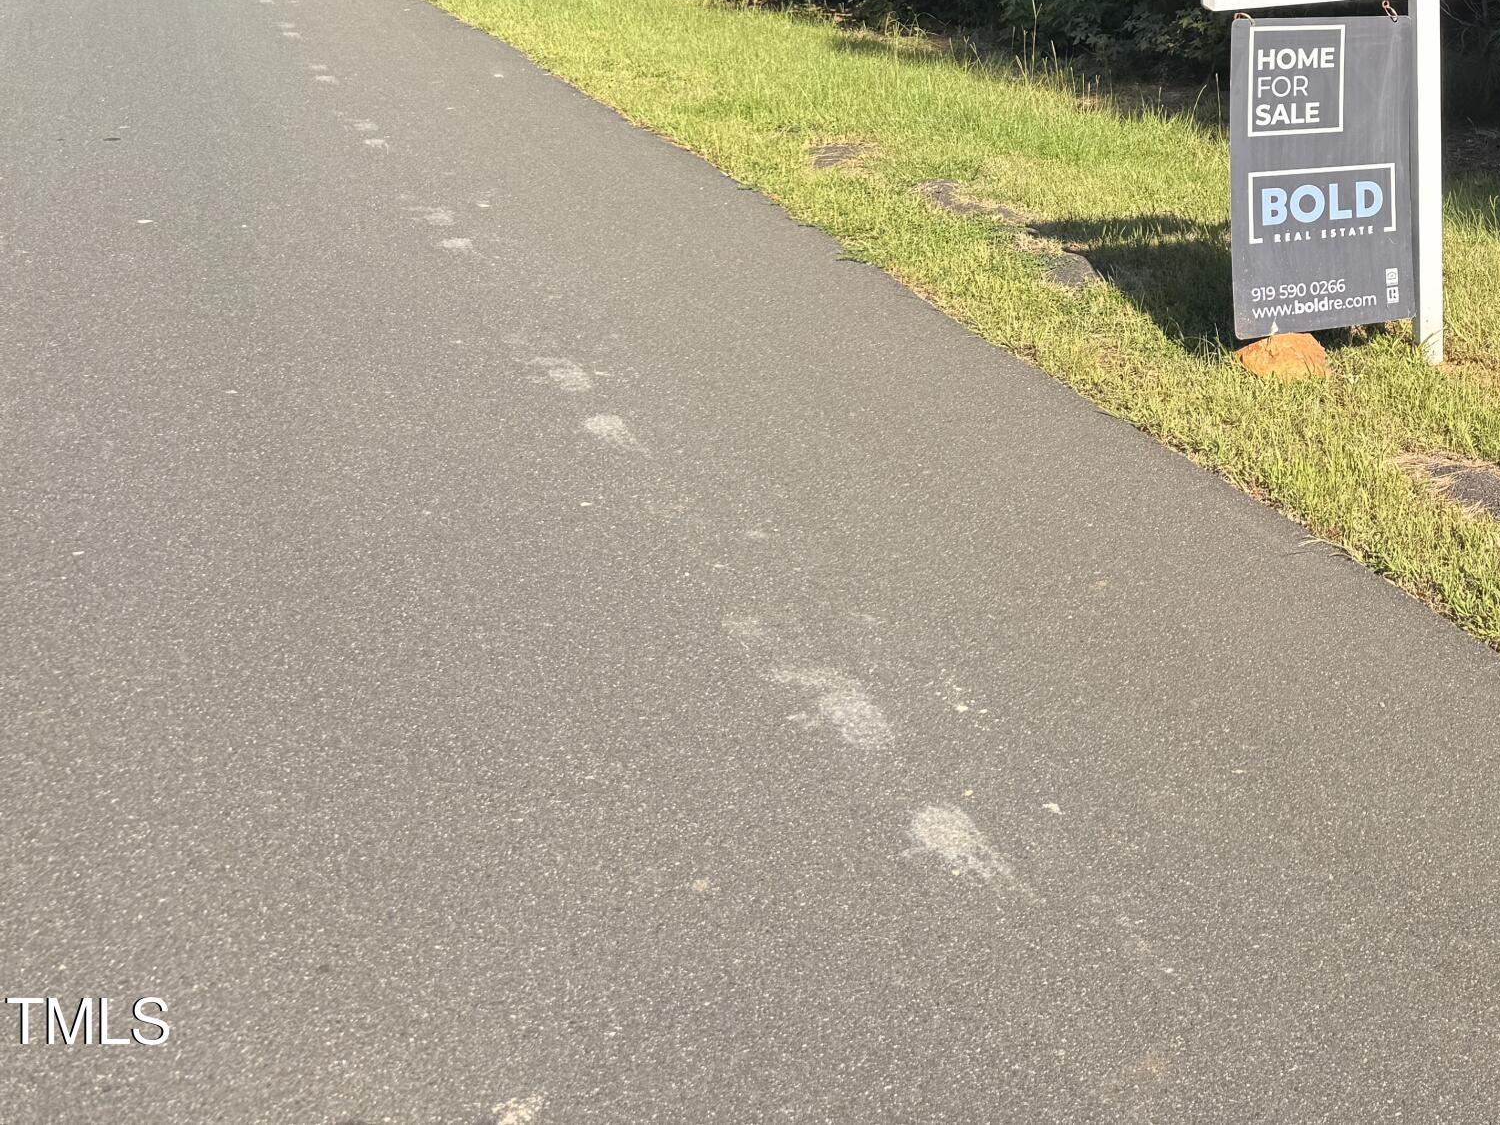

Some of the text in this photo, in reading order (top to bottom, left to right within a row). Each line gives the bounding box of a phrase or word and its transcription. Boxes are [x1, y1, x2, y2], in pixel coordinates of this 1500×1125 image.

[1257, 47, 1335, 71] HOME
[1257, 75, 1309, 98] FOR
[1255, 102, 1320, 126] SALE
[1261, 181, 1384, 225] BOLD
[1274, 225, 1374, 243] REAL ESTATE
[1251, 279, 1346, 302] 919 590 0266
[1252, 294, 1377, 319] www.boldre.com
